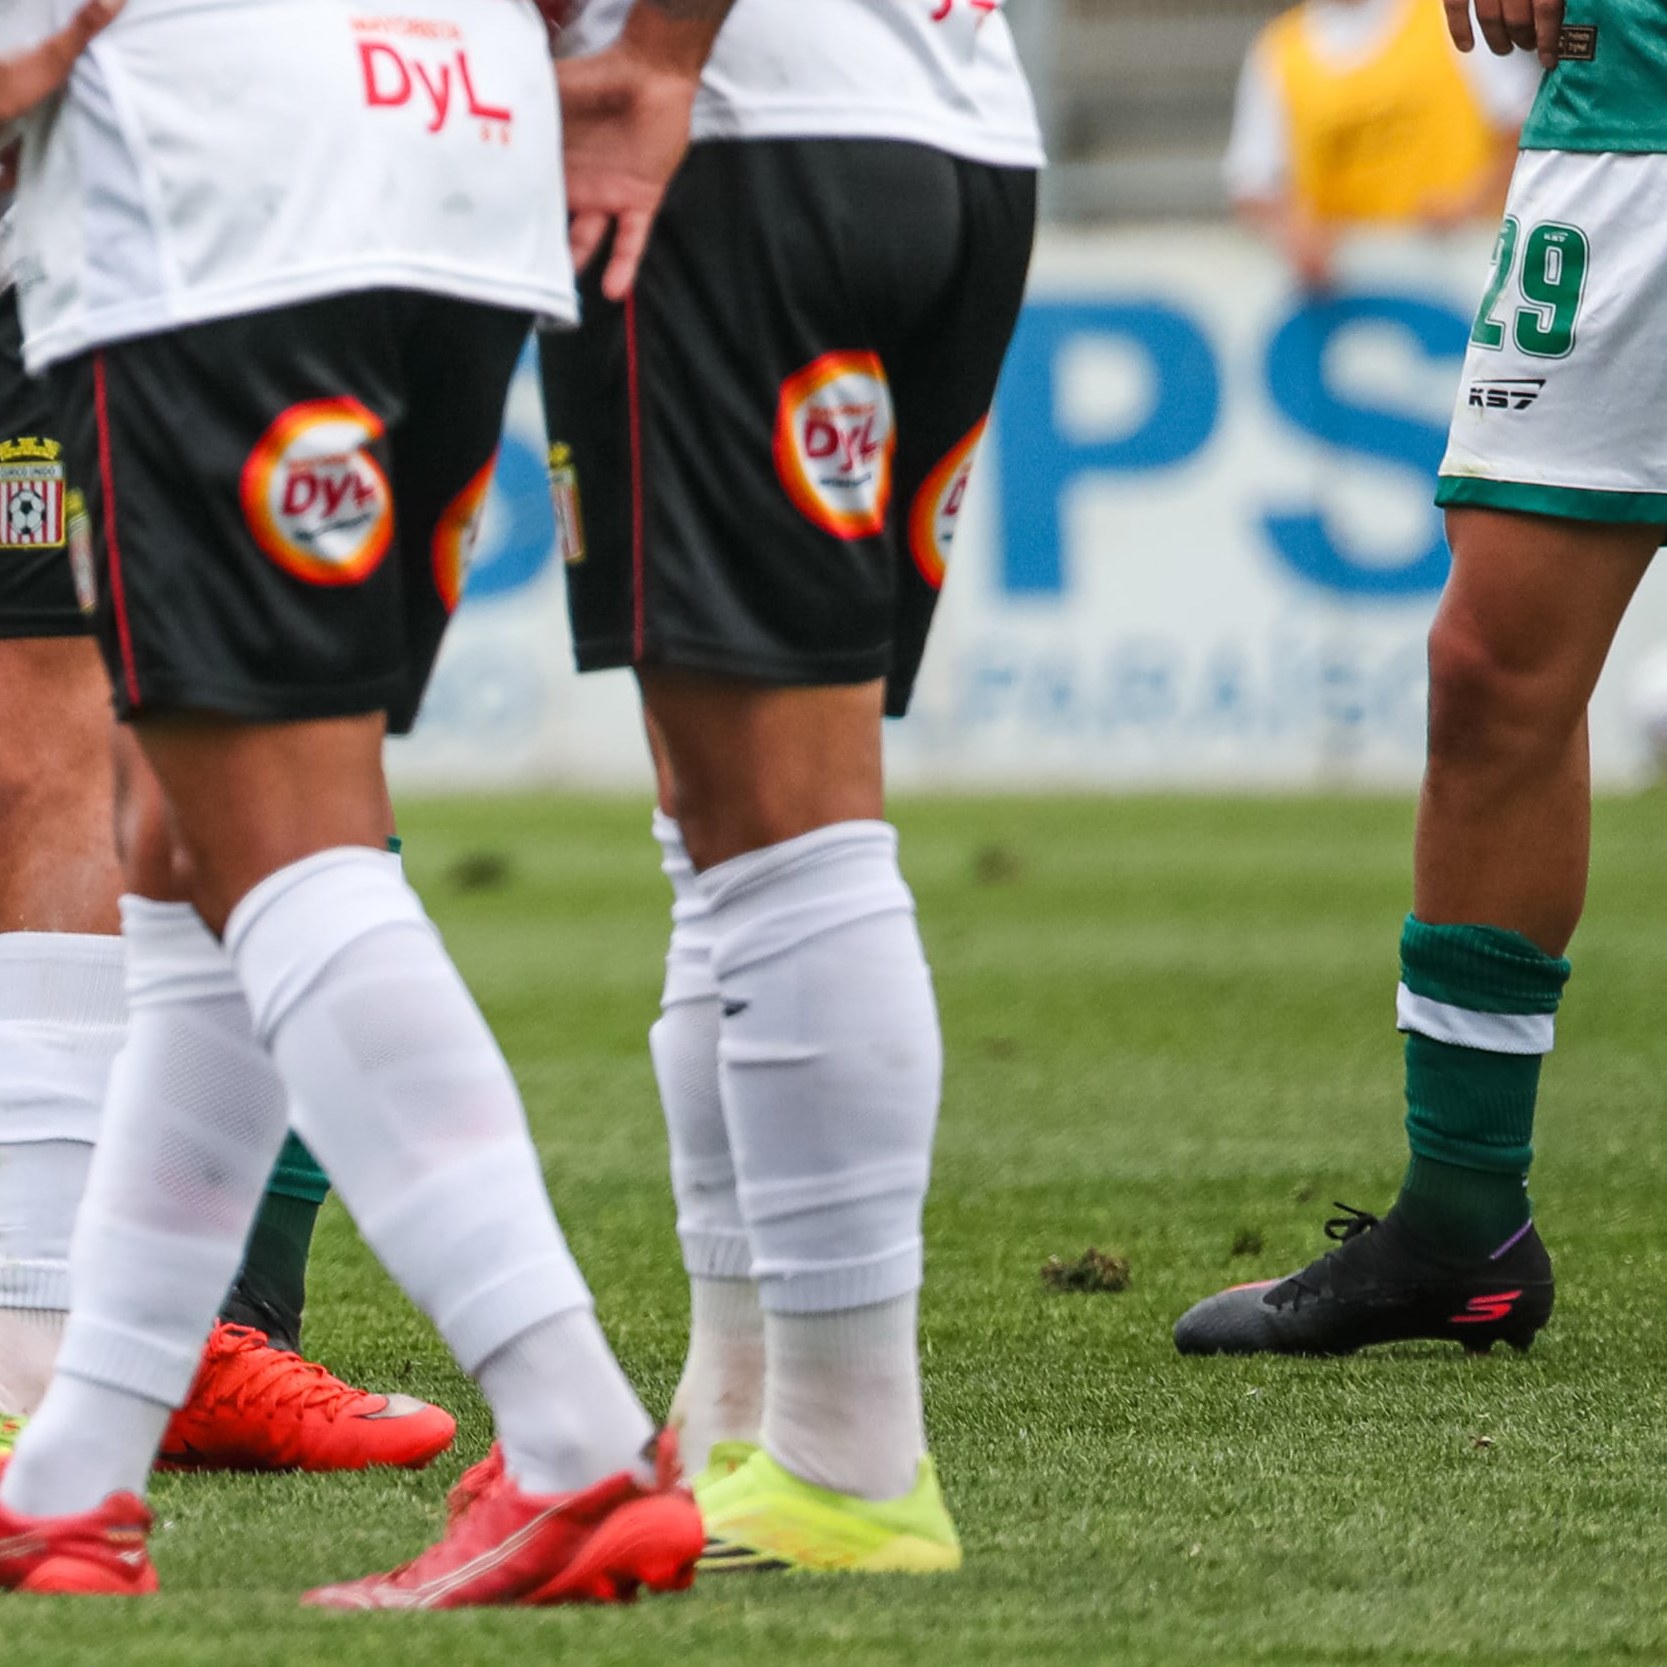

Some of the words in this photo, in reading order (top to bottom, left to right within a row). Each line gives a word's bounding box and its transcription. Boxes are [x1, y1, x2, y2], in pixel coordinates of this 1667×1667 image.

[357, 40, 512, 134] DyL
[1469, 213, 1590, 359] 29
[992, 289, 1472, 606] PS
[1468, 387, 1538, 410] KS7
